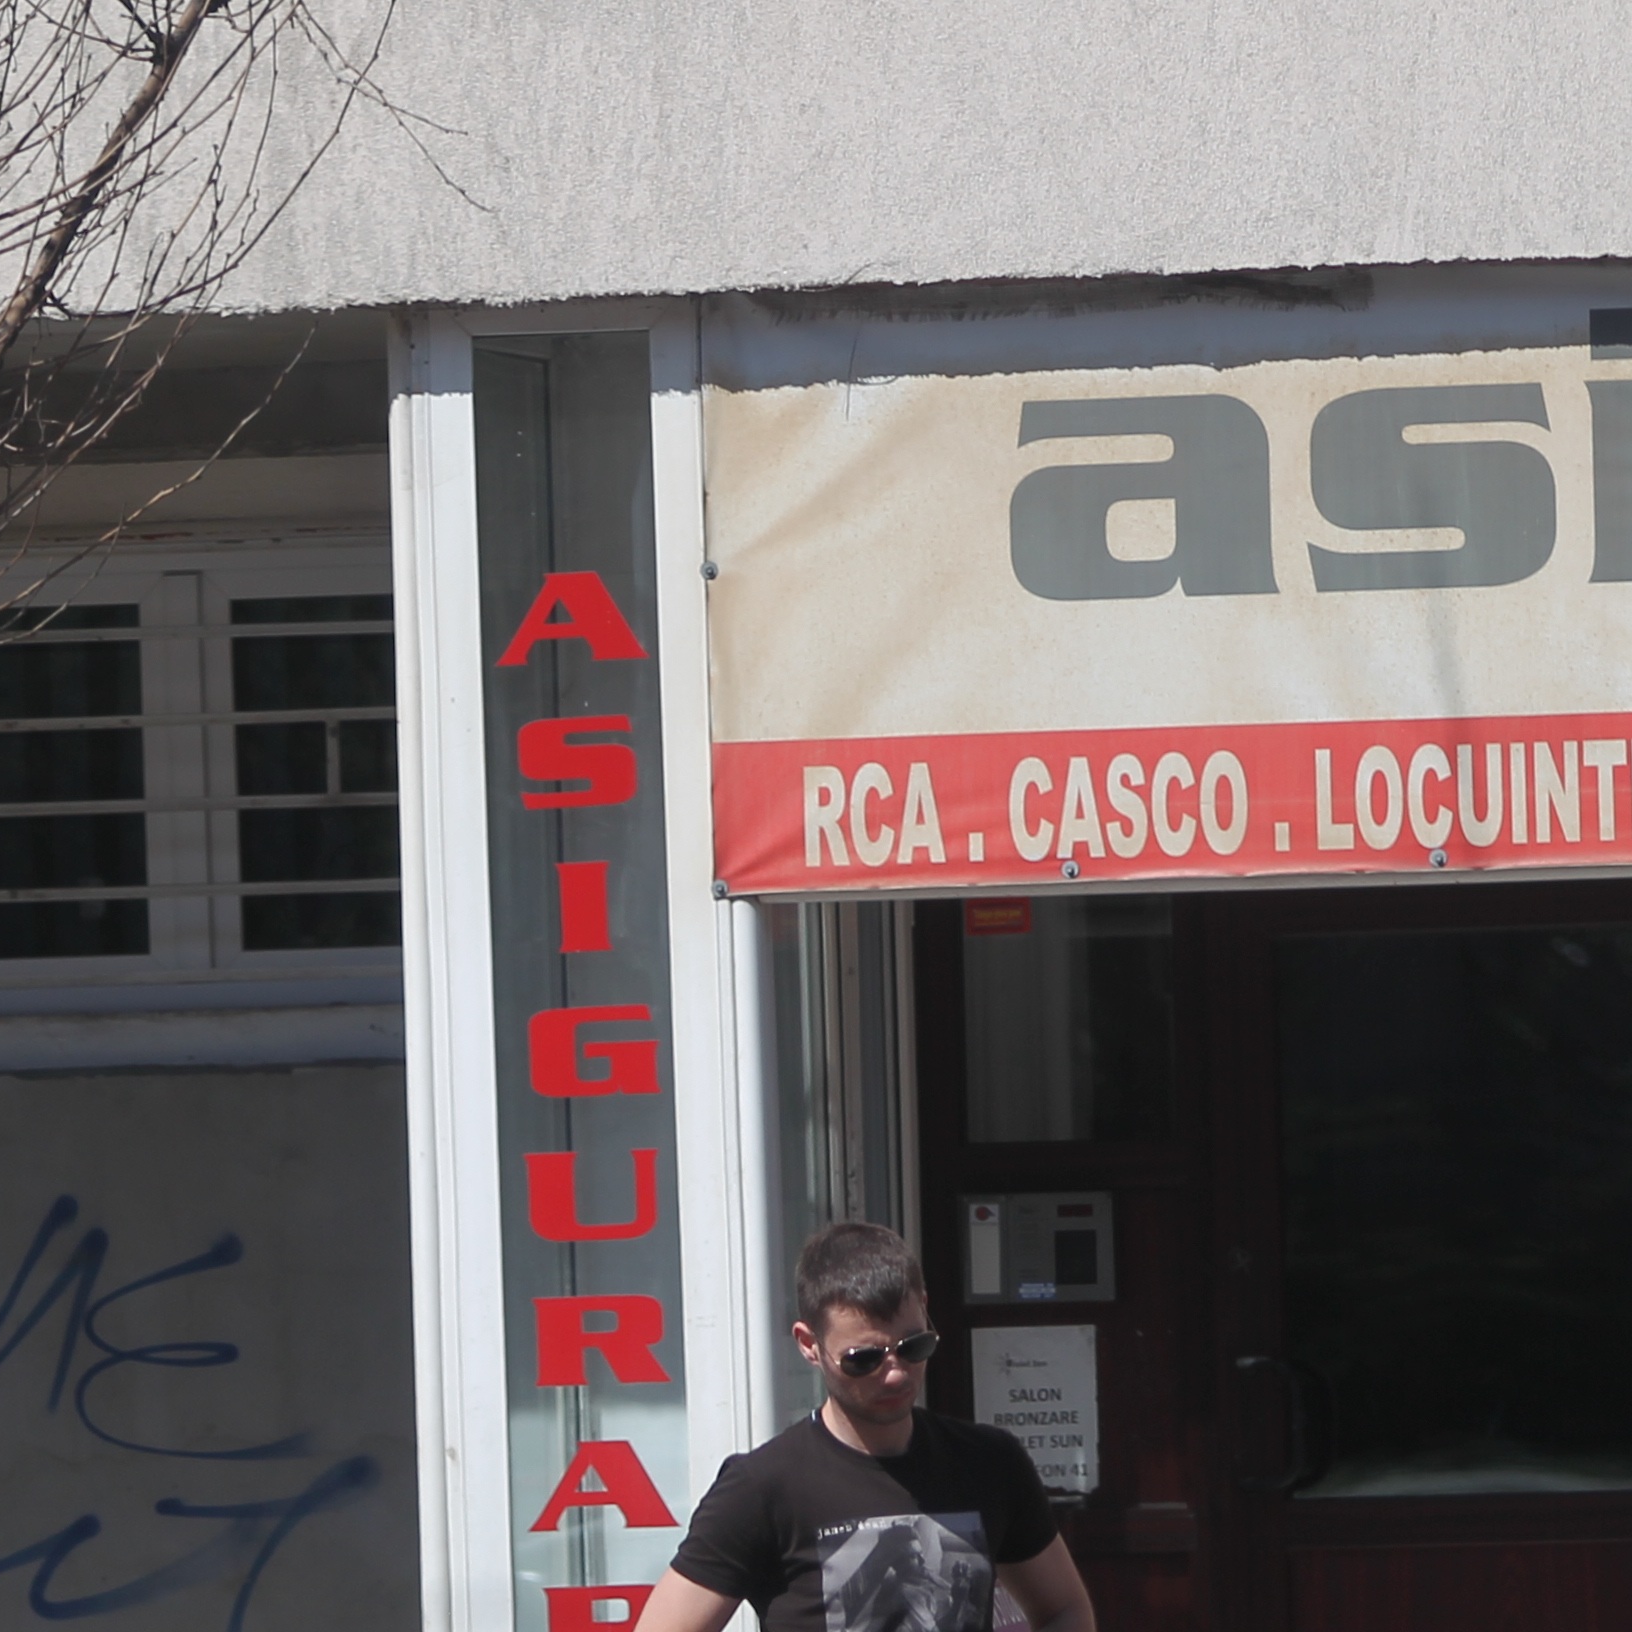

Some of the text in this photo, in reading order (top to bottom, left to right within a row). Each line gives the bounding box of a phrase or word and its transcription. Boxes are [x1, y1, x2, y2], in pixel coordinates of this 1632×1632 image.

[802, 762, 946, 868] RCA
[1008, 749, 1248, 861] CASCO
[1008, 1387, 1063, 1403] SALON
[994, 1410, 1079, 1427] BRONZARE
[1049, 1434, 1084, 1448] SUN
